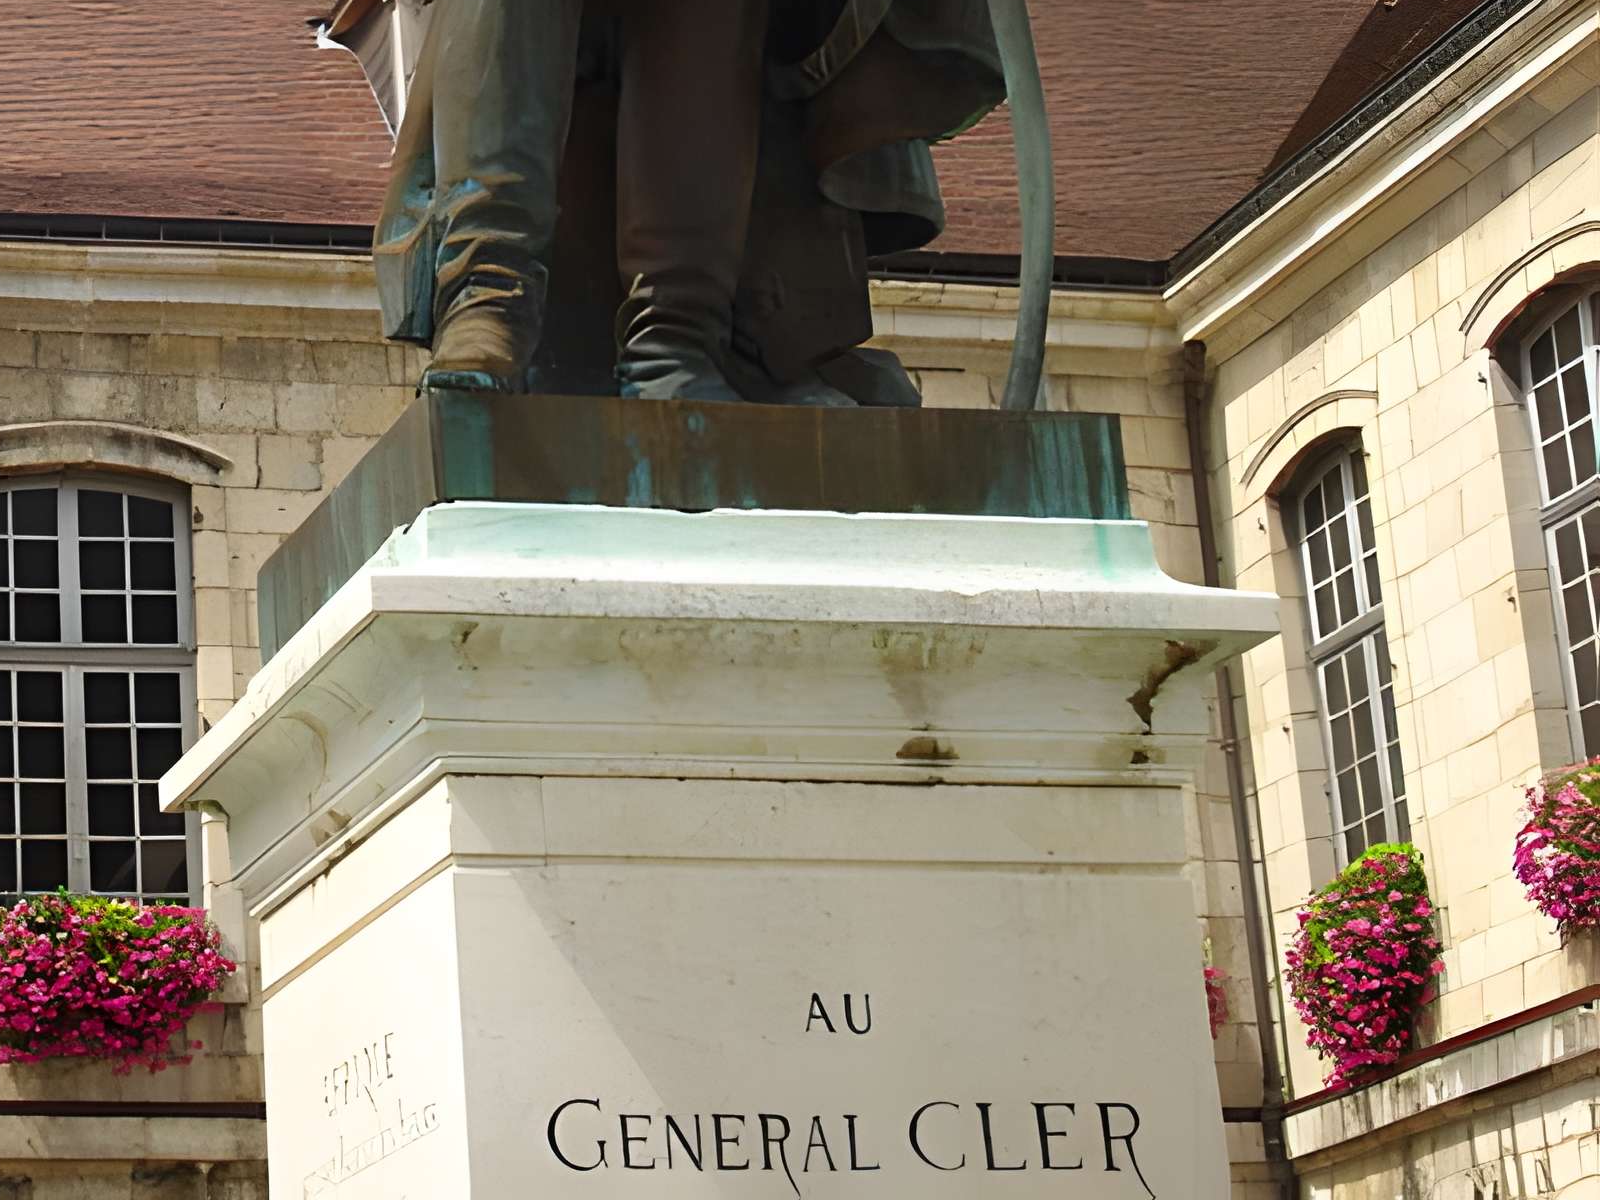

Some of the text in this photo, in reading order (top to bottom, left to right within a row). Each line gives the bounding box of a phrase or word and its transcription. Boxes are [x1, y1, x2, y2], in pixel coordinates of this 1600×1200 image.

[805, 992, 872, 1035] AU
[547, 1098, 881, 1200] GENERAL
[908, 1101, 1156, 1200] CLER
